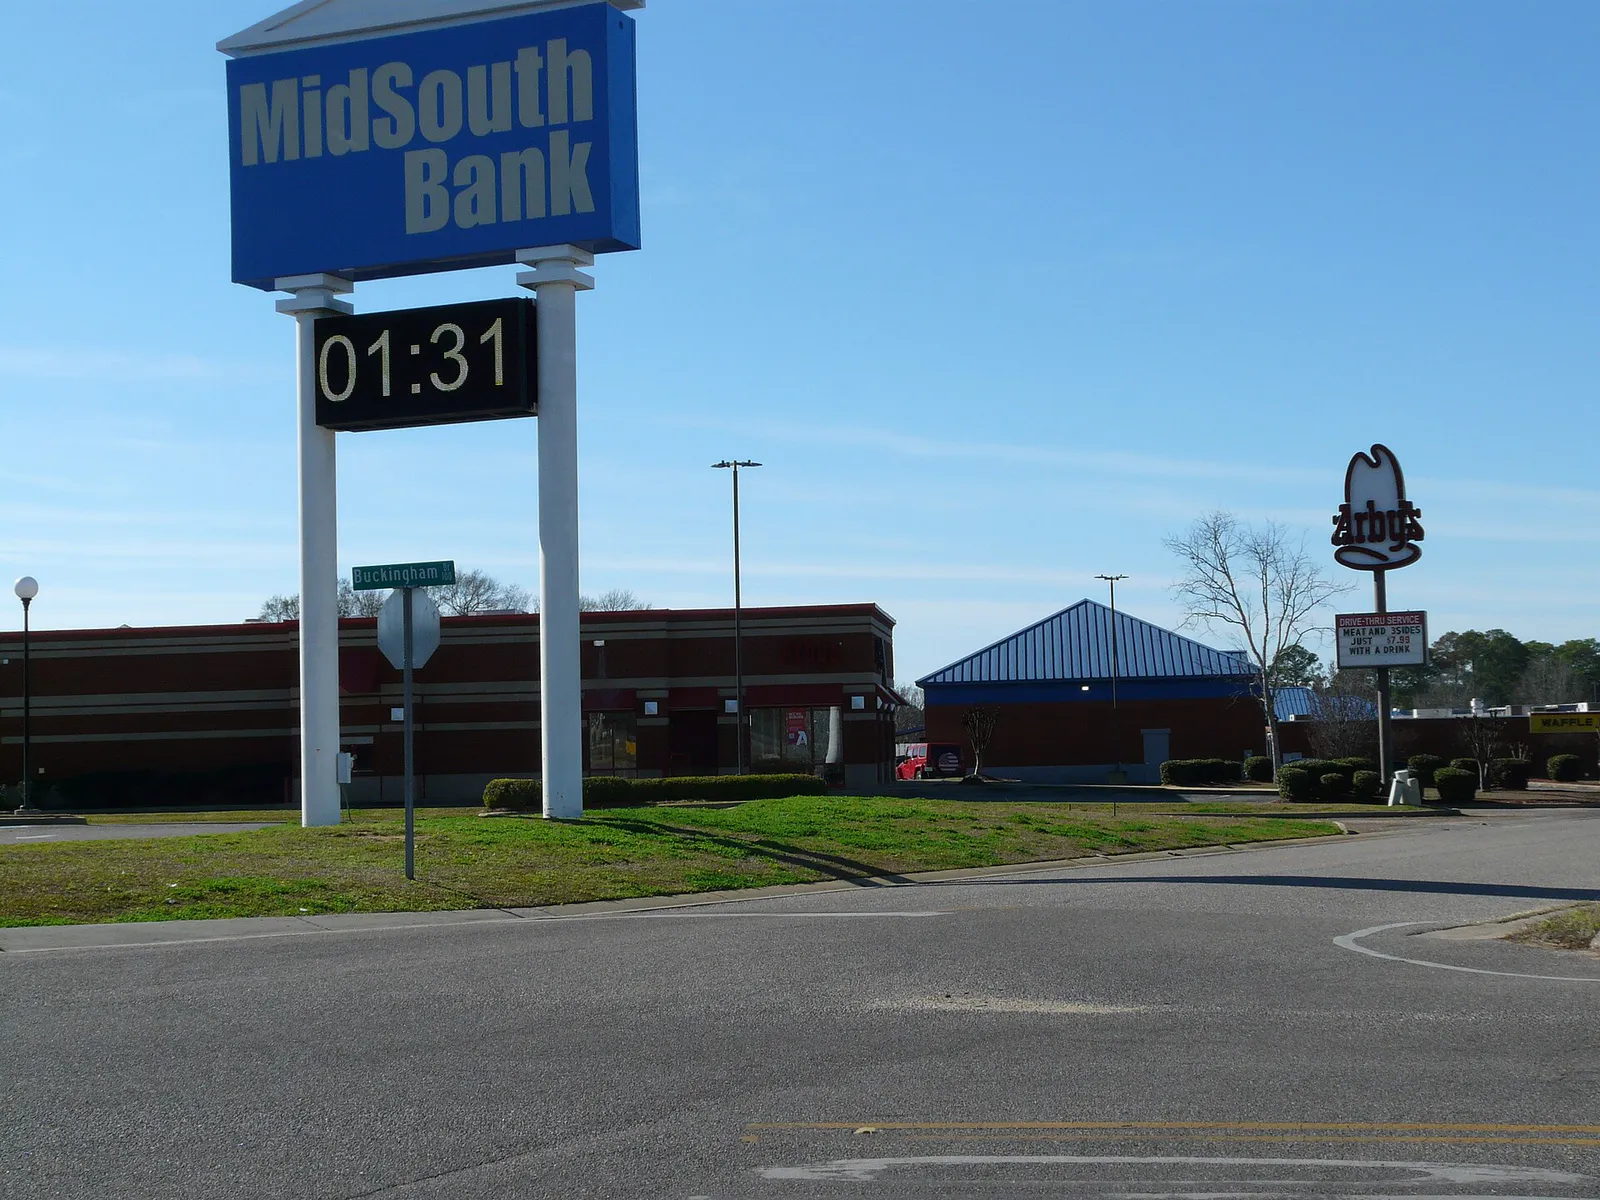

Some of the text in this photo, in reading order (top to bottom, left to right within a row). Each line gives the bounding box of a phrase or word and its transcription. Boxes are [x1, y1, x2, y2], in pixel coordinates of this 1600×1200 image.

[239, 37, 593, 166] MidSouth
[404, 130, 596, 235] Bank
[319, 317, 504, 402] 01:31
[1331, 499, 1425, 552] Arby's
[354, 565, 438, 584] Buckingham
[1339, 615, 1420, 626] DRIVE-THRU SERVICE
[1343, 628, 1366, 637] MEAT
[1368, 627, 1386, 636] AND
[1351, 636, 1411, 646] JUST $7.99
[1349, 645, 1411, 655] WITH A DRINK
[1541, 718, 1593, 726] WAFFLE
